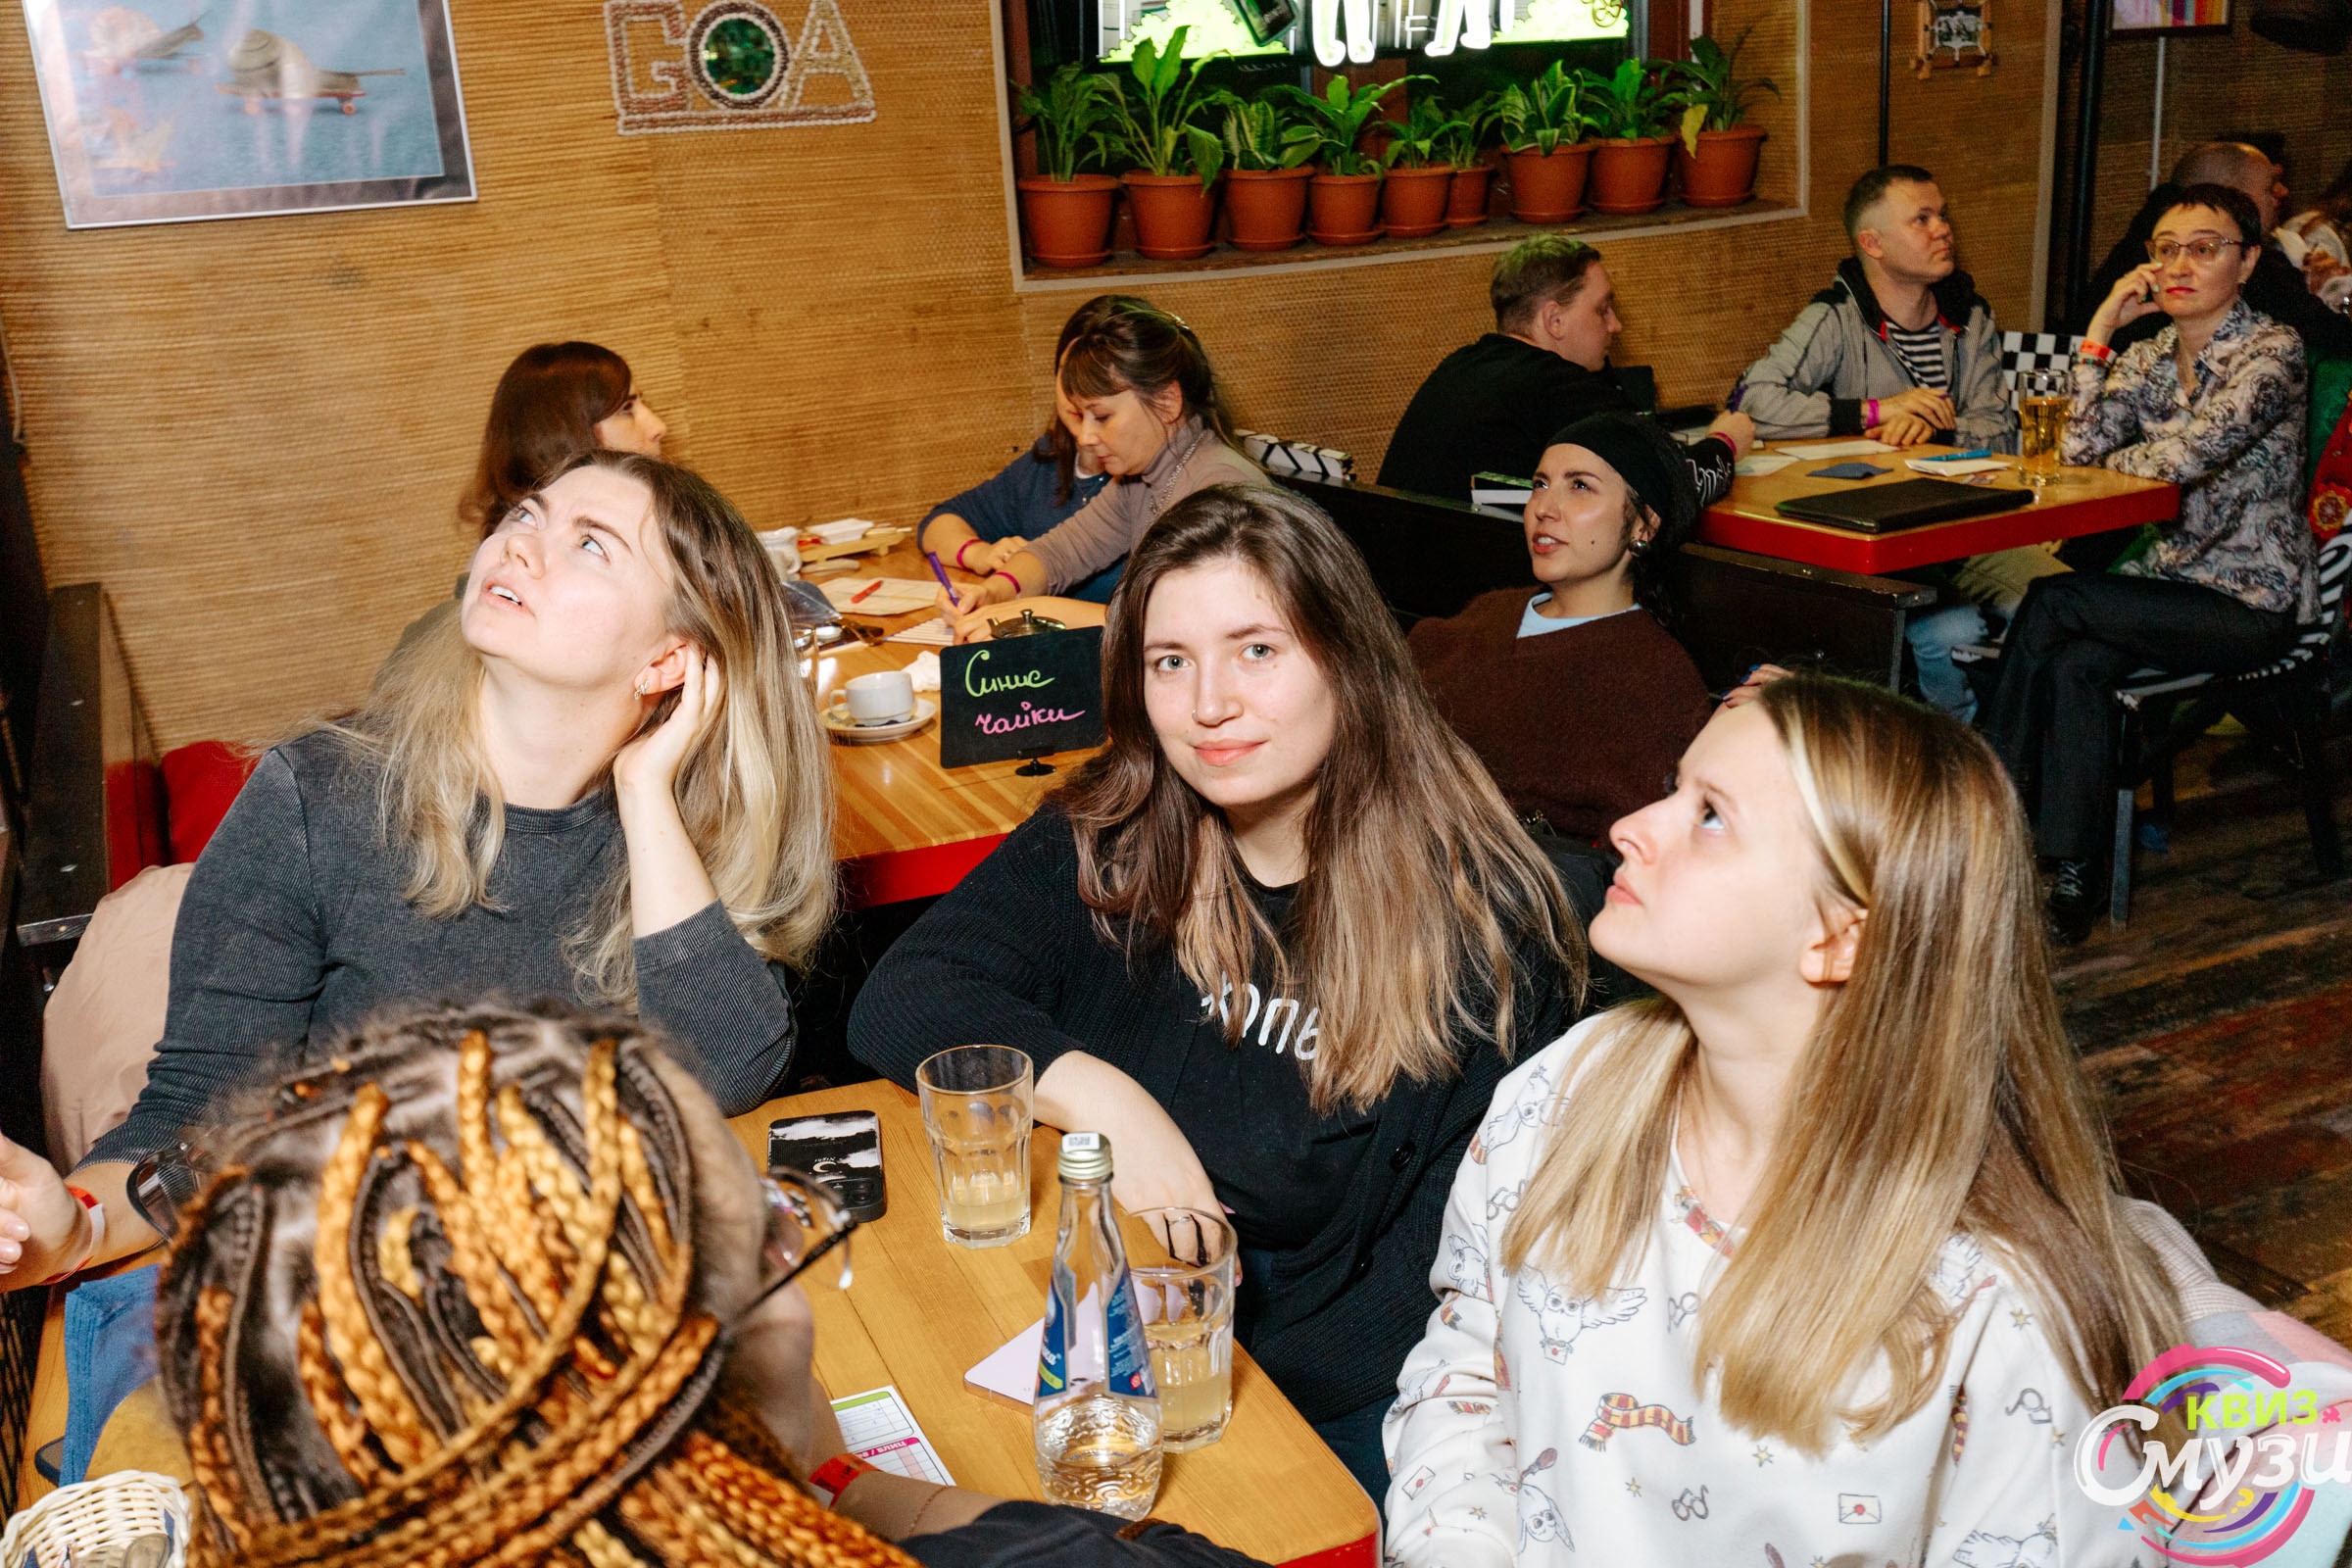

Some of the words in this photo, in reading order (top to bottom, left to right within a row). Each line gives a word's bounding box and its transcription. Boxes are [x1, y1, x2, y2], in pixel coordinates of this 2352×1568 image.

[604, 0, 875, 120] GOA
[965, 650, 1055, 697] Синие
[974, 701, 1086, 734] чайки
